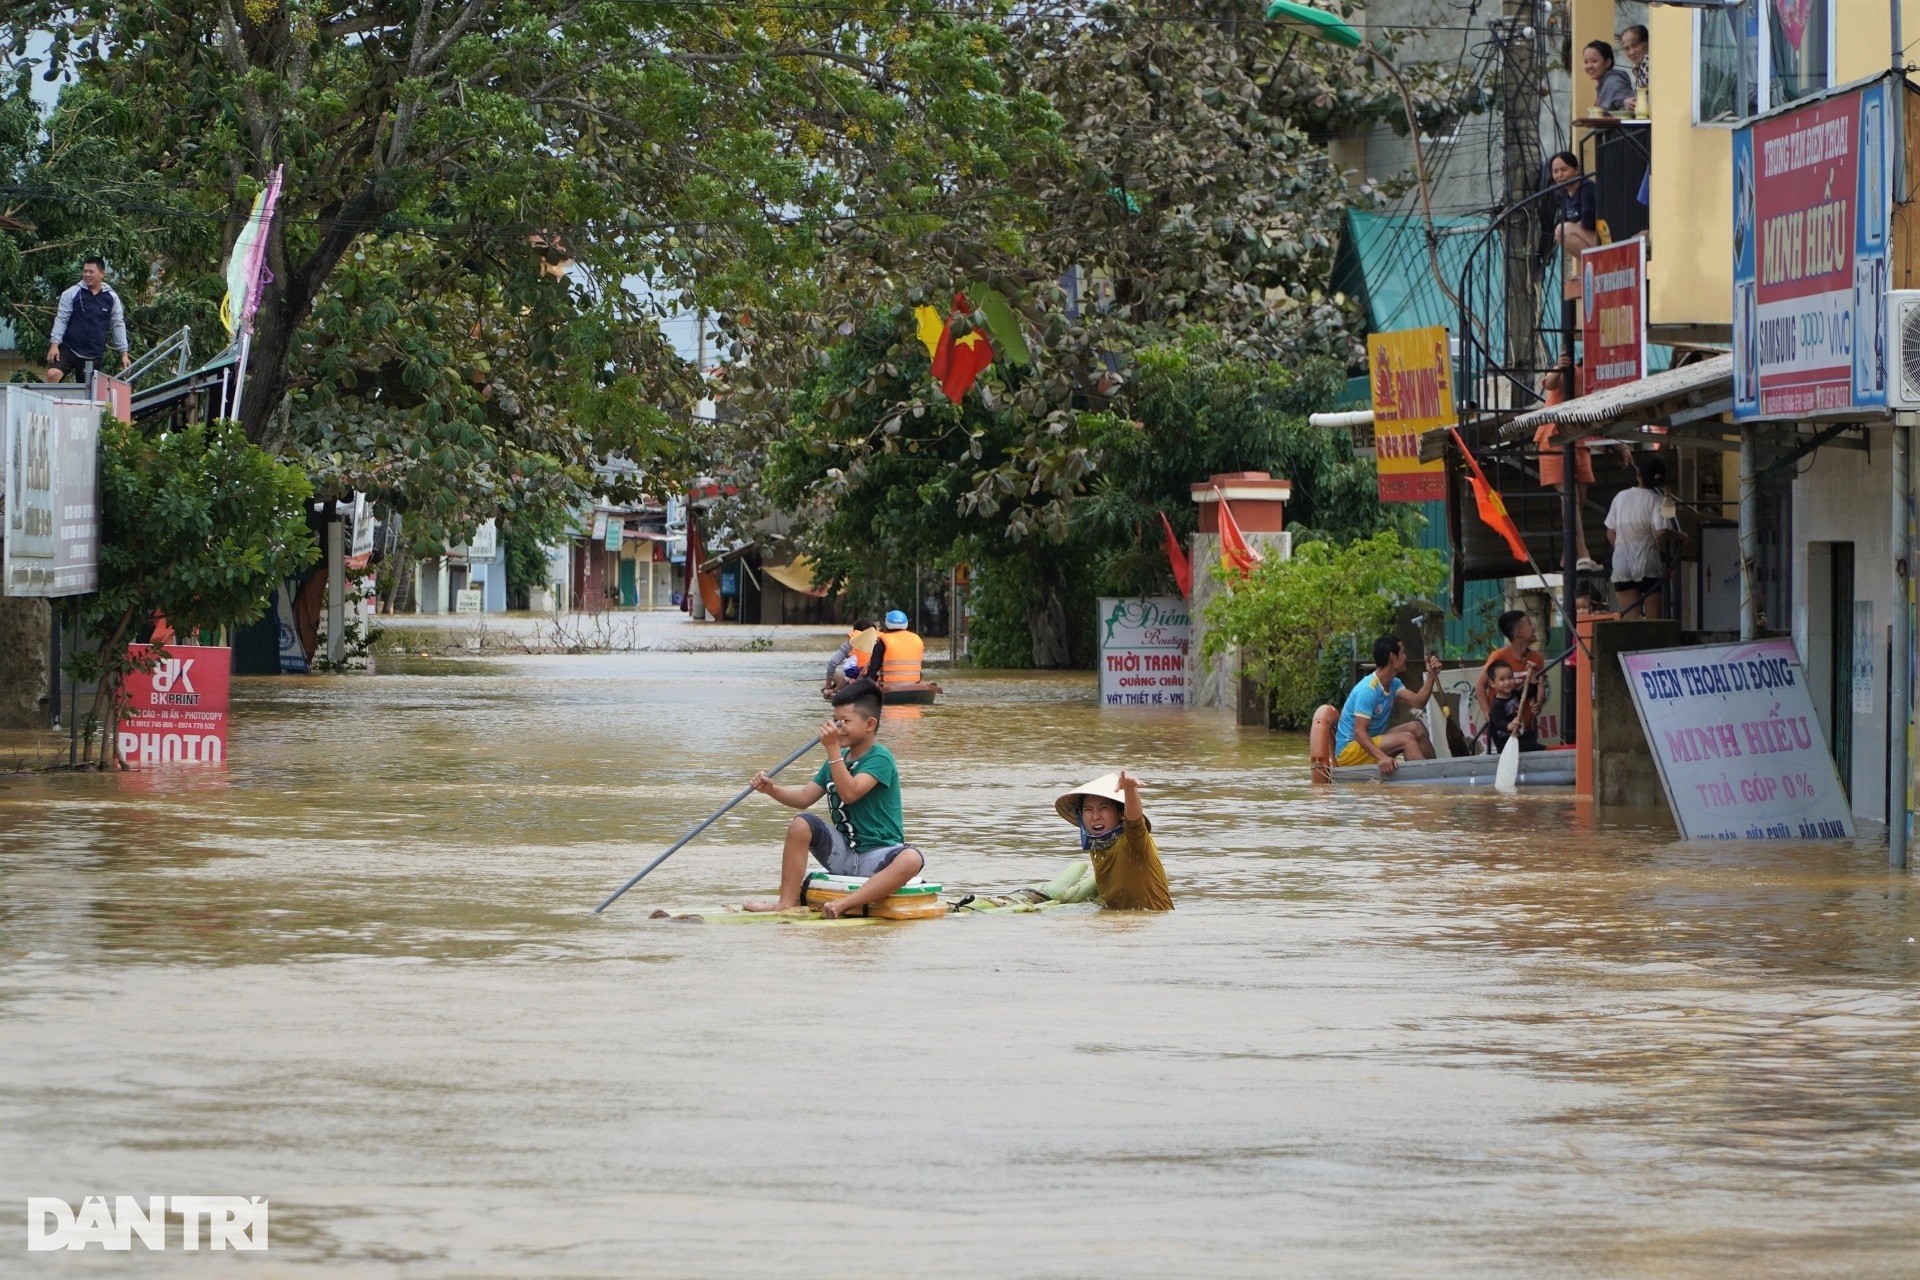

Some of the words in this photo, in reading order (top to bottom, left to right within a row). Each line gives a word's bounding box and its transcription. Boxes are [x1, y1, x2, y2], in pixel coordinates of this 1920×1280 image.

[1764, 135, 1790, 178] TRUNG
[1790, 117, 1806, 171] TÂM
[1805, 110, 1825, 174] ĐIỆN
[1824, 115, 1849, 166] THOẠI
[1762, 210, 1804, 286] MINH
[1805, 167, 1847, 277] HIẾU
[1759, 314, 1796, 367] SAMSUNG
[1827, 298, 1850, 356] vivo
[1141, 627, 1189, 650] Boutiqu
[1106, 651, 1140, 672] THỜI
[1144, 655, 1184, 671] TRAN
[1641, 662, 1684, 706] ĐIỆN
[1682, 663, 1730, 700] THOẠI
[1729, 661, 1750, 692] DI
[1750, 652, 1796, 696] ĐỘNG
[1119, 674, 1156, 688] QUẢNG
[1125, 690, 1149, 704] THIẾT
[1151, 690, 1163, 703] KẾ
[142, 708, 156, 719] CÁO
[161, 710, 168, 719] IN
[169, 708, 179, 719] ẤN
[185, 711, 223, 720] PHOTOCOPY
[118, 732, 222, 766] PHOTO
[1663, 723, 1742, 763] MINH
[1740, 702, 1812, 755] HIẾU
[1695, 772, 1738, 809] TRẢ
[1740, 771, 1777, 804] GÓP
